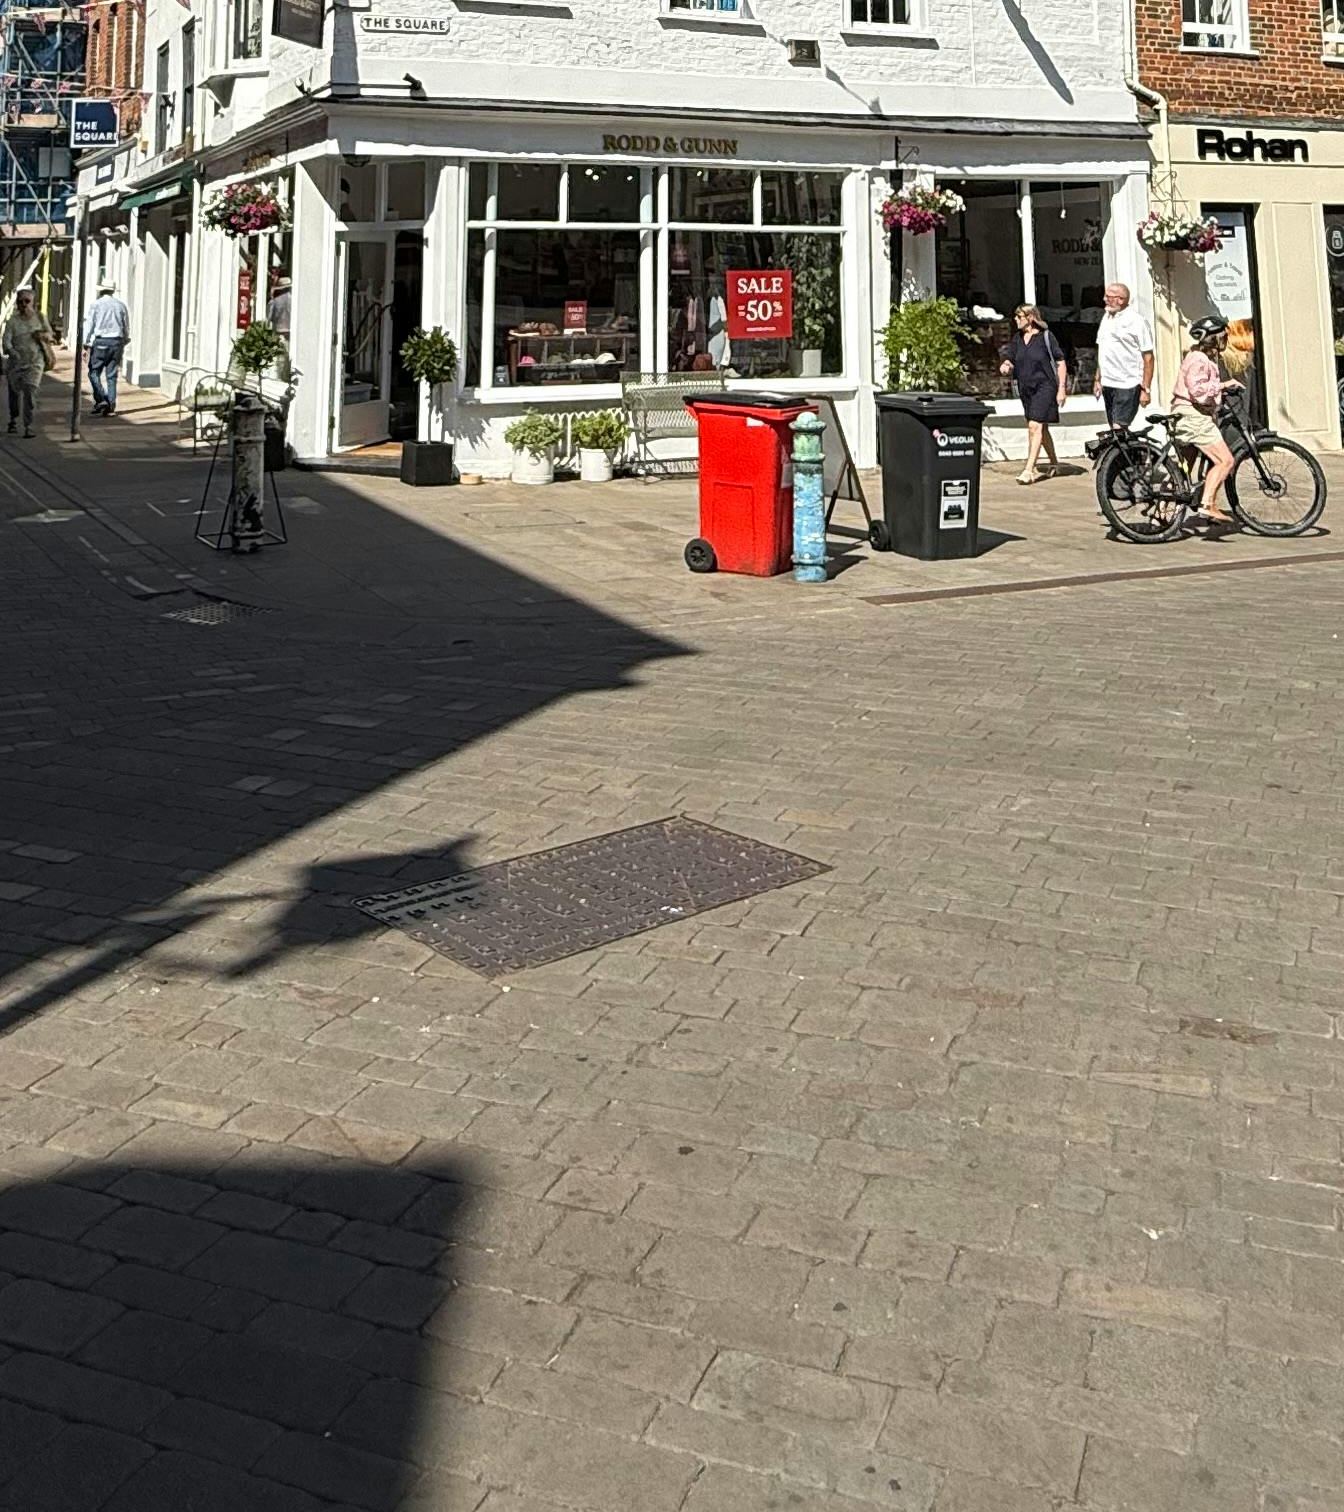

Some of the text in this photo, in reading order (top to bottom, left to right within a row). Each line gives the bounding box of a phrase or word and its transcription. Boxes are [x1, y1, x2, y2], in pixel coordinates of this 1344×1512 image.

[363, 17, 446, 30] THE SQUARE
[75, 121, 97, 130] THE
[602, 134, 738, 155] RODD & GUNN
[1196, 128, 1309, 163] Rohan
[737, 277, 784, 293] SALE
[949, 435, 975, 445] VEOLIA
